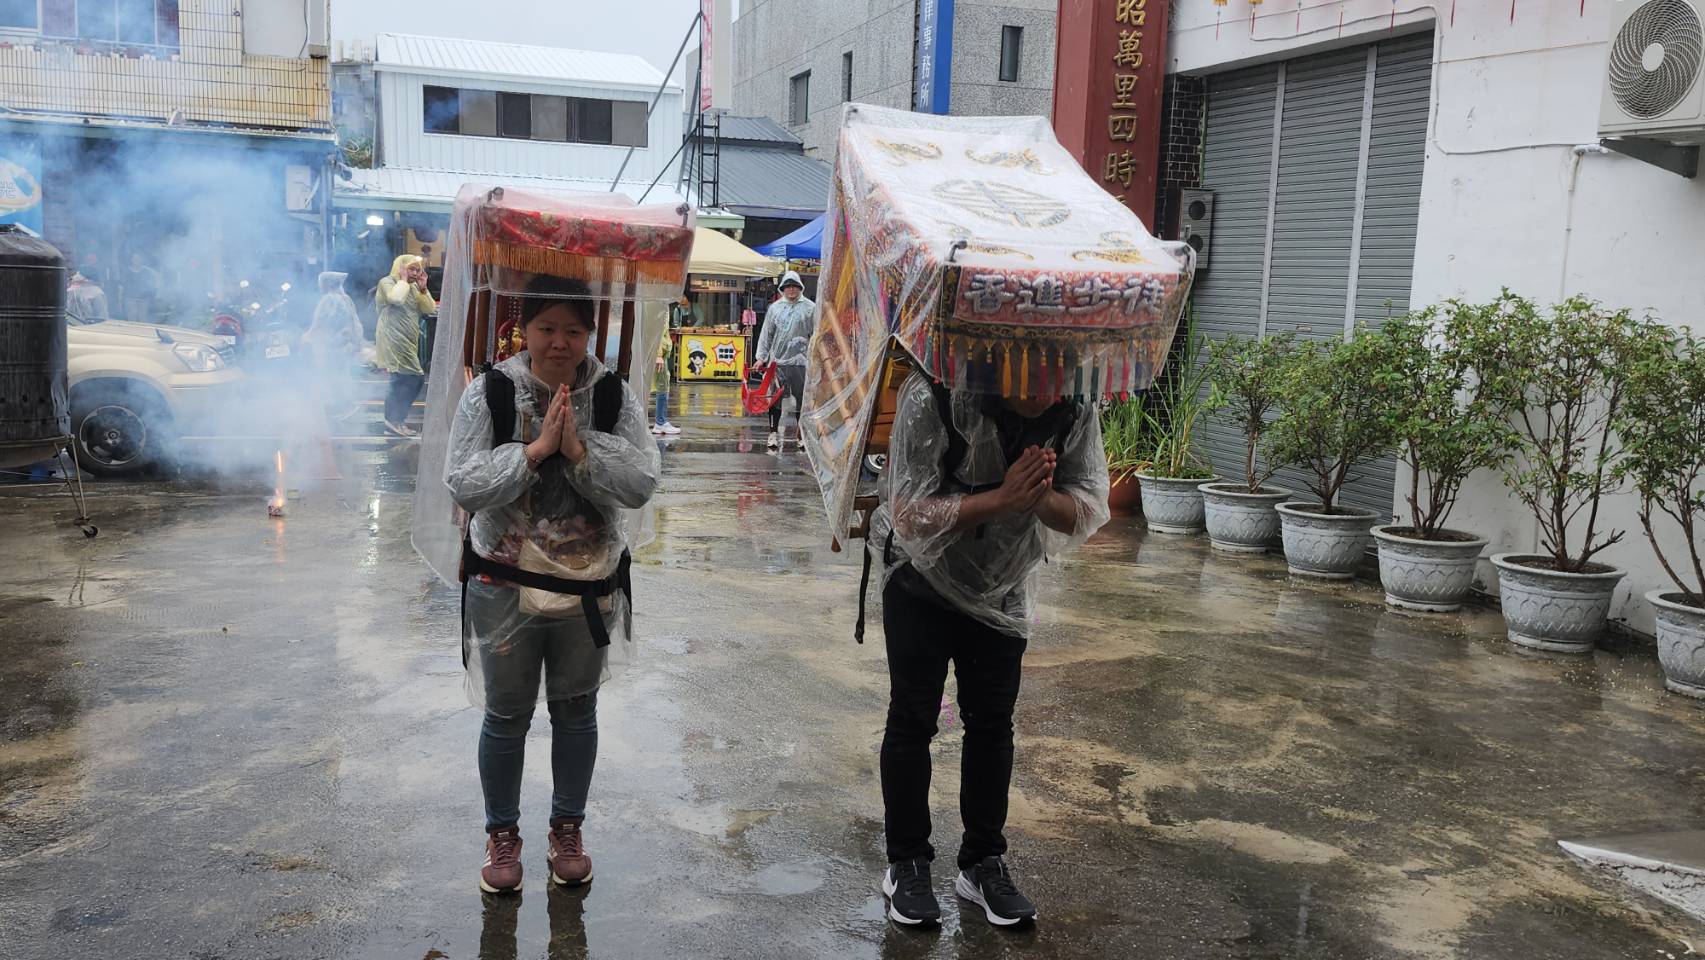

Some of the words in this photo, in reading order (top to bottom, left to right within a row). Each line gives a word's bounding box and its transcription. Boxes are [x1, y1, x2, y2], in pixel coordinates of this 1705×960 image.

[1104, 0, 1147, 205] 昭萬里四時
